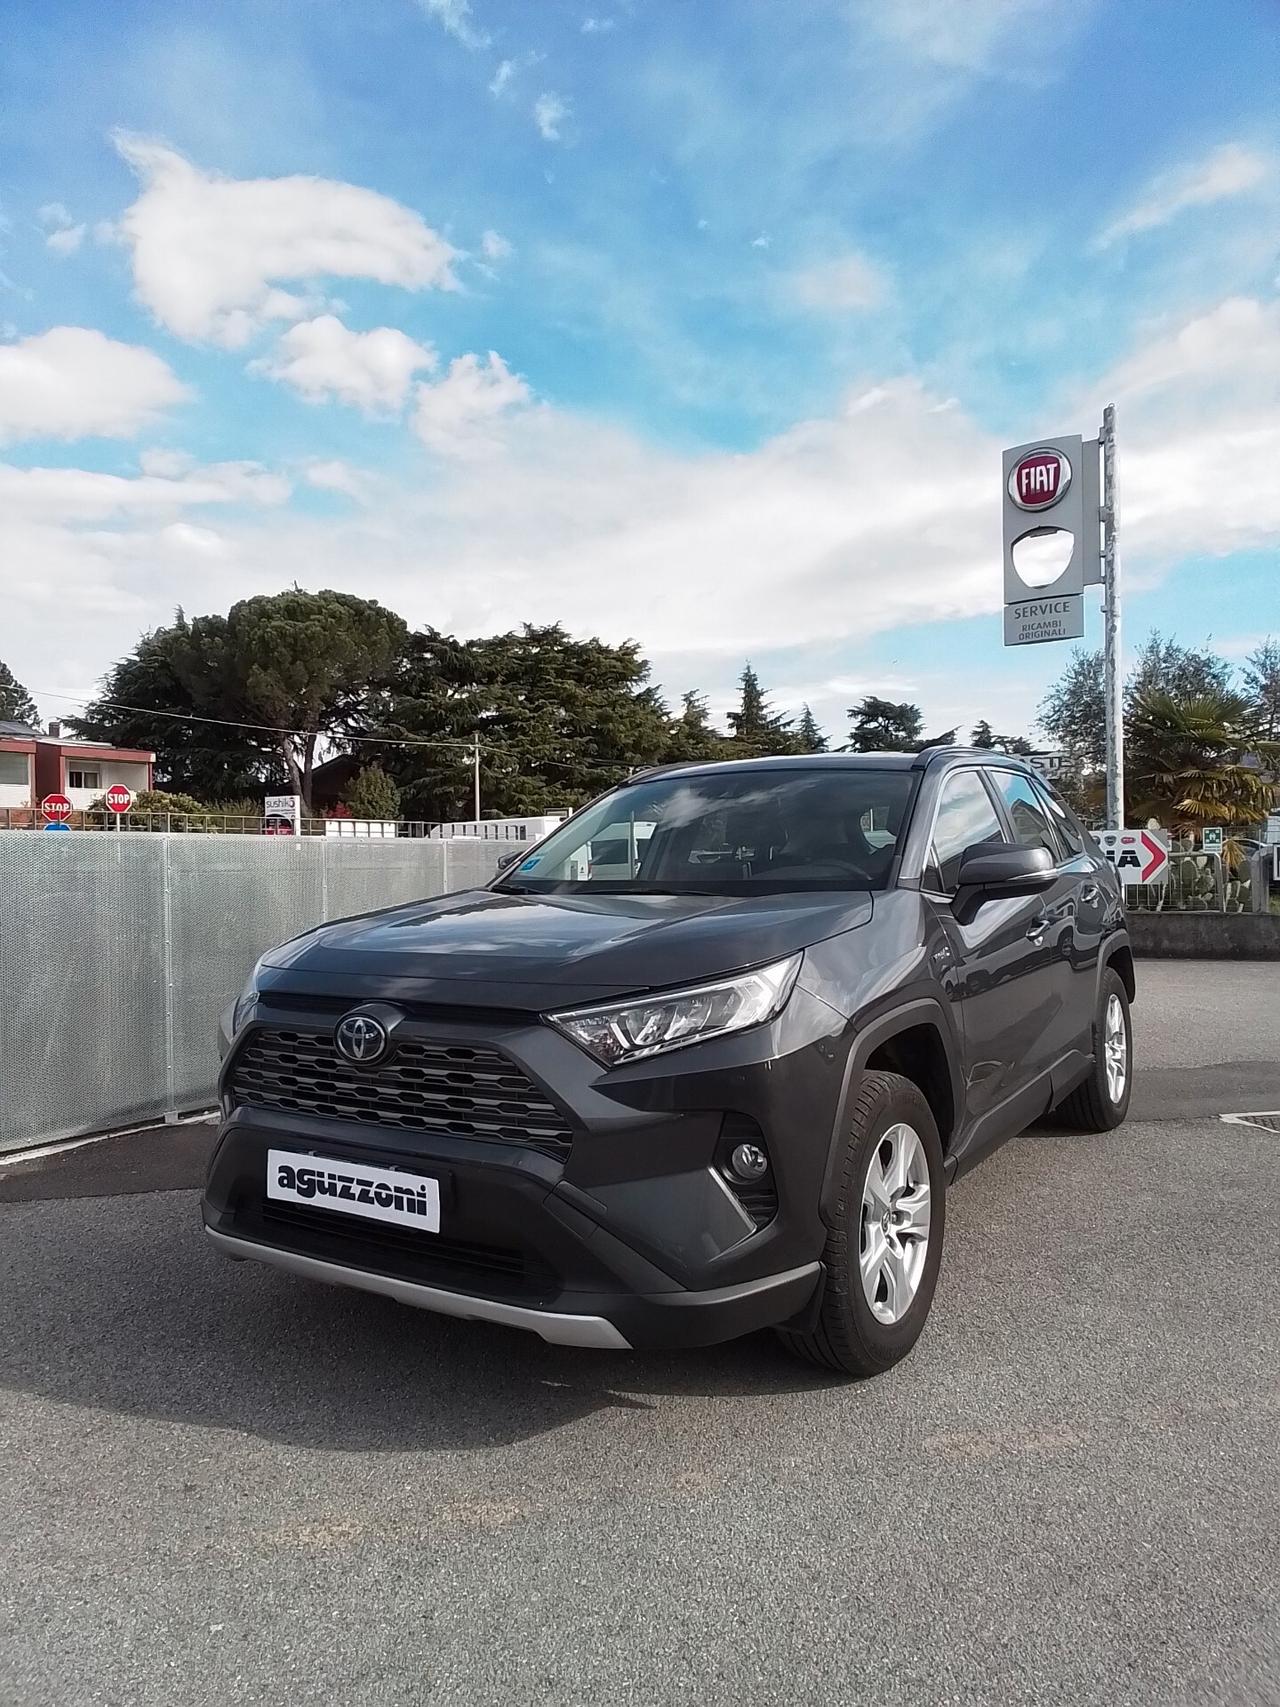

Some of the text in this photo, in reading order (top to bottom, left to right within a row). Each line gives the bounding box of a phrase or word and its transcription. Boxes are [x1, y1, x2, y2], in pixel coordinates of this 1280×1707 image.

[1021, 463, 1058, 496] FIAT
[1014, 601, 1071, 620] SERVICE
[1021, 620, 1062, 632] RICAMBI
[1018, 628, 1066, 641] ORIGINALI
[107, 793, 130, 804] STOP
[44, 802, 69, 813] STOP
[277, 1165, 428, 1216] aguzzoni
